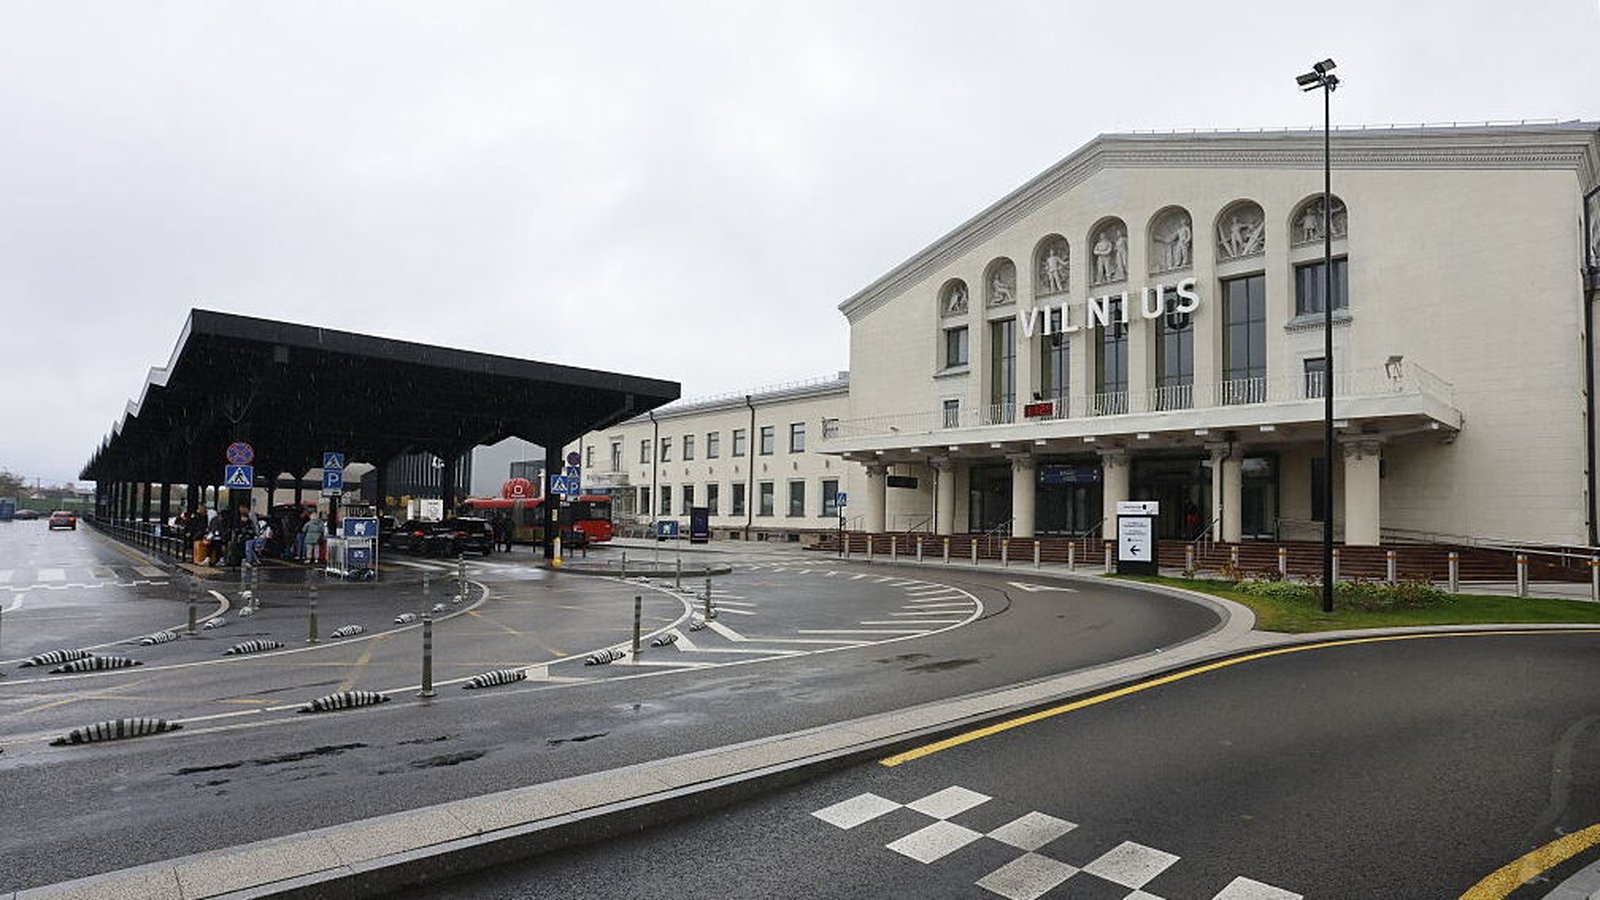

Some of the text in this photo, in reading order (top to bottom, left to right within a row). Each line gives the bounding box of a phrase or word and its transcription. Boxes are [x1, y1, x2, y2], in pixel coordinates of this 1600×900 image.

[1019, 277, 1200, 338] VILNIUS
[328, 473, 339, 487] P
[570, 482, 579, 494] P
